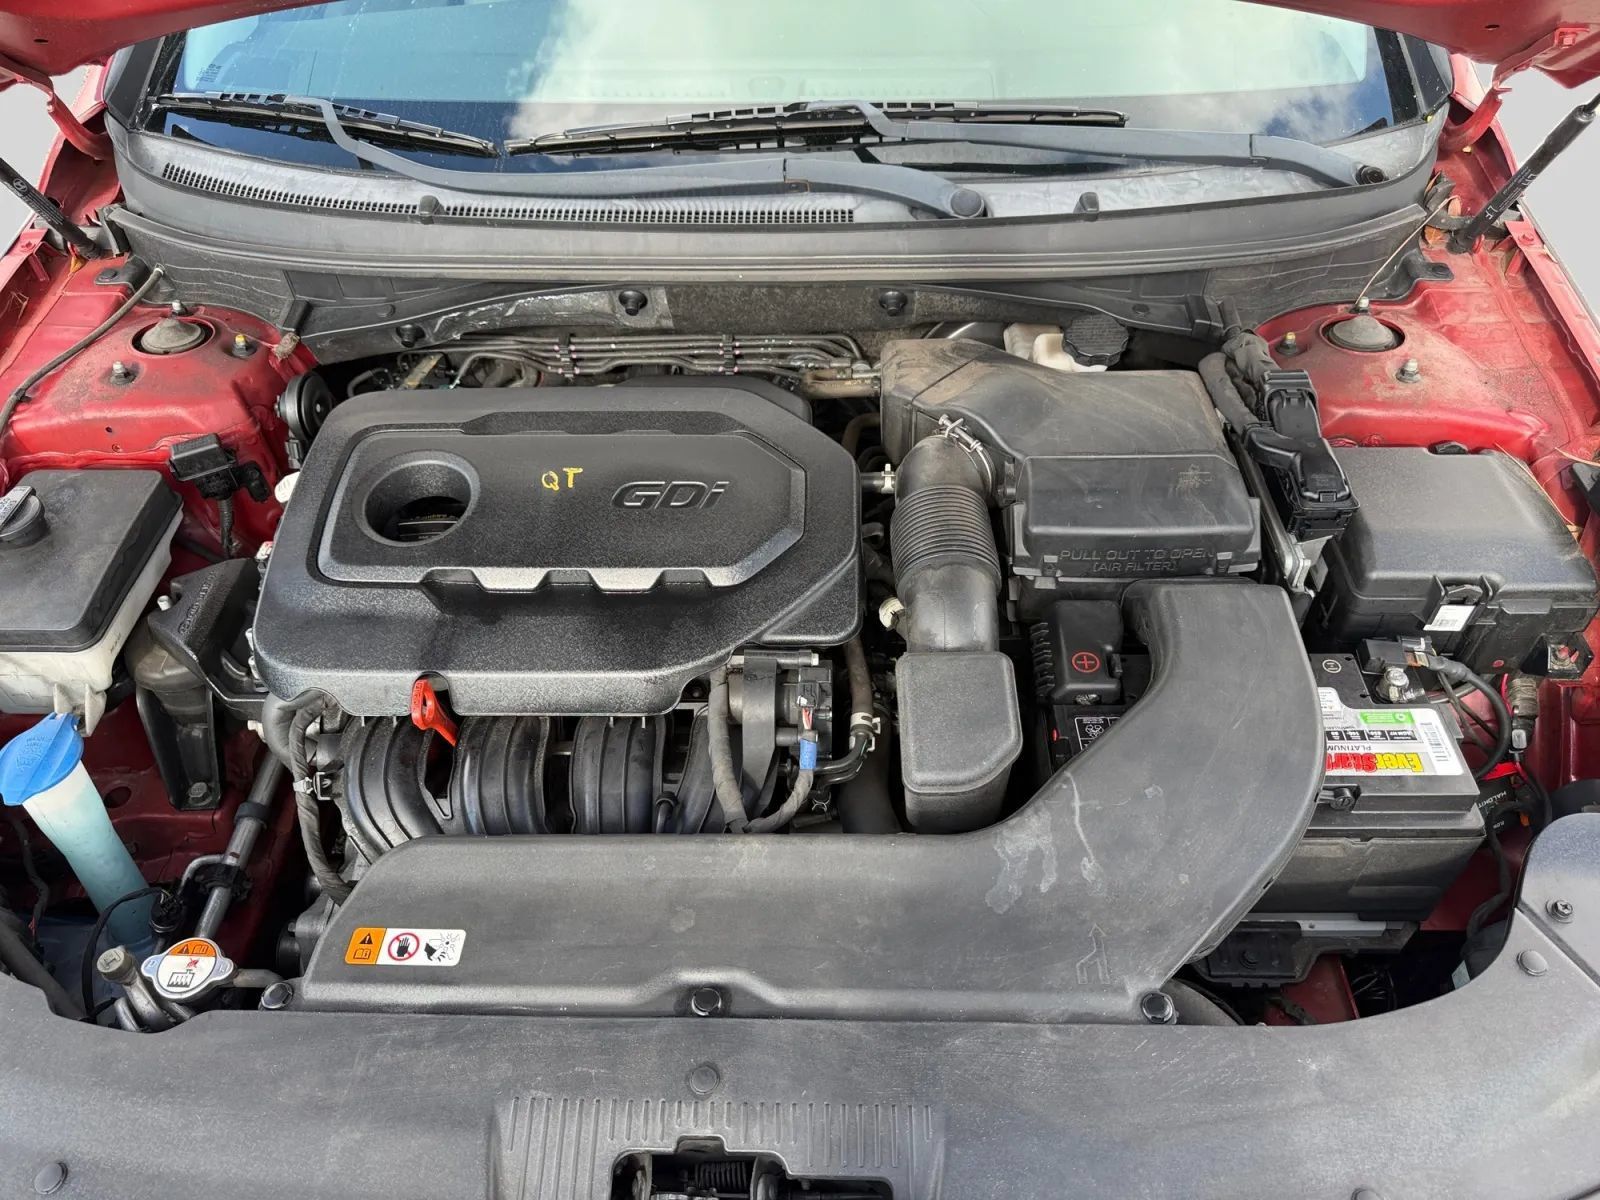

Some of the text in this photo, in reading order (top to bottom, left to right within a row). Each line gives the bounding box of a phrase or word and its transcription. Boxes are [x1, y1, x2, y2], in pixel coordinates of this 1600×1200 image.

[1484, 205, 1499, 220] LF
[541, 467, 583, 491] QT
[610, 481, 730, 510] GDi
[1059, 548, 1215, 561] PULL OUT TO OPEN
